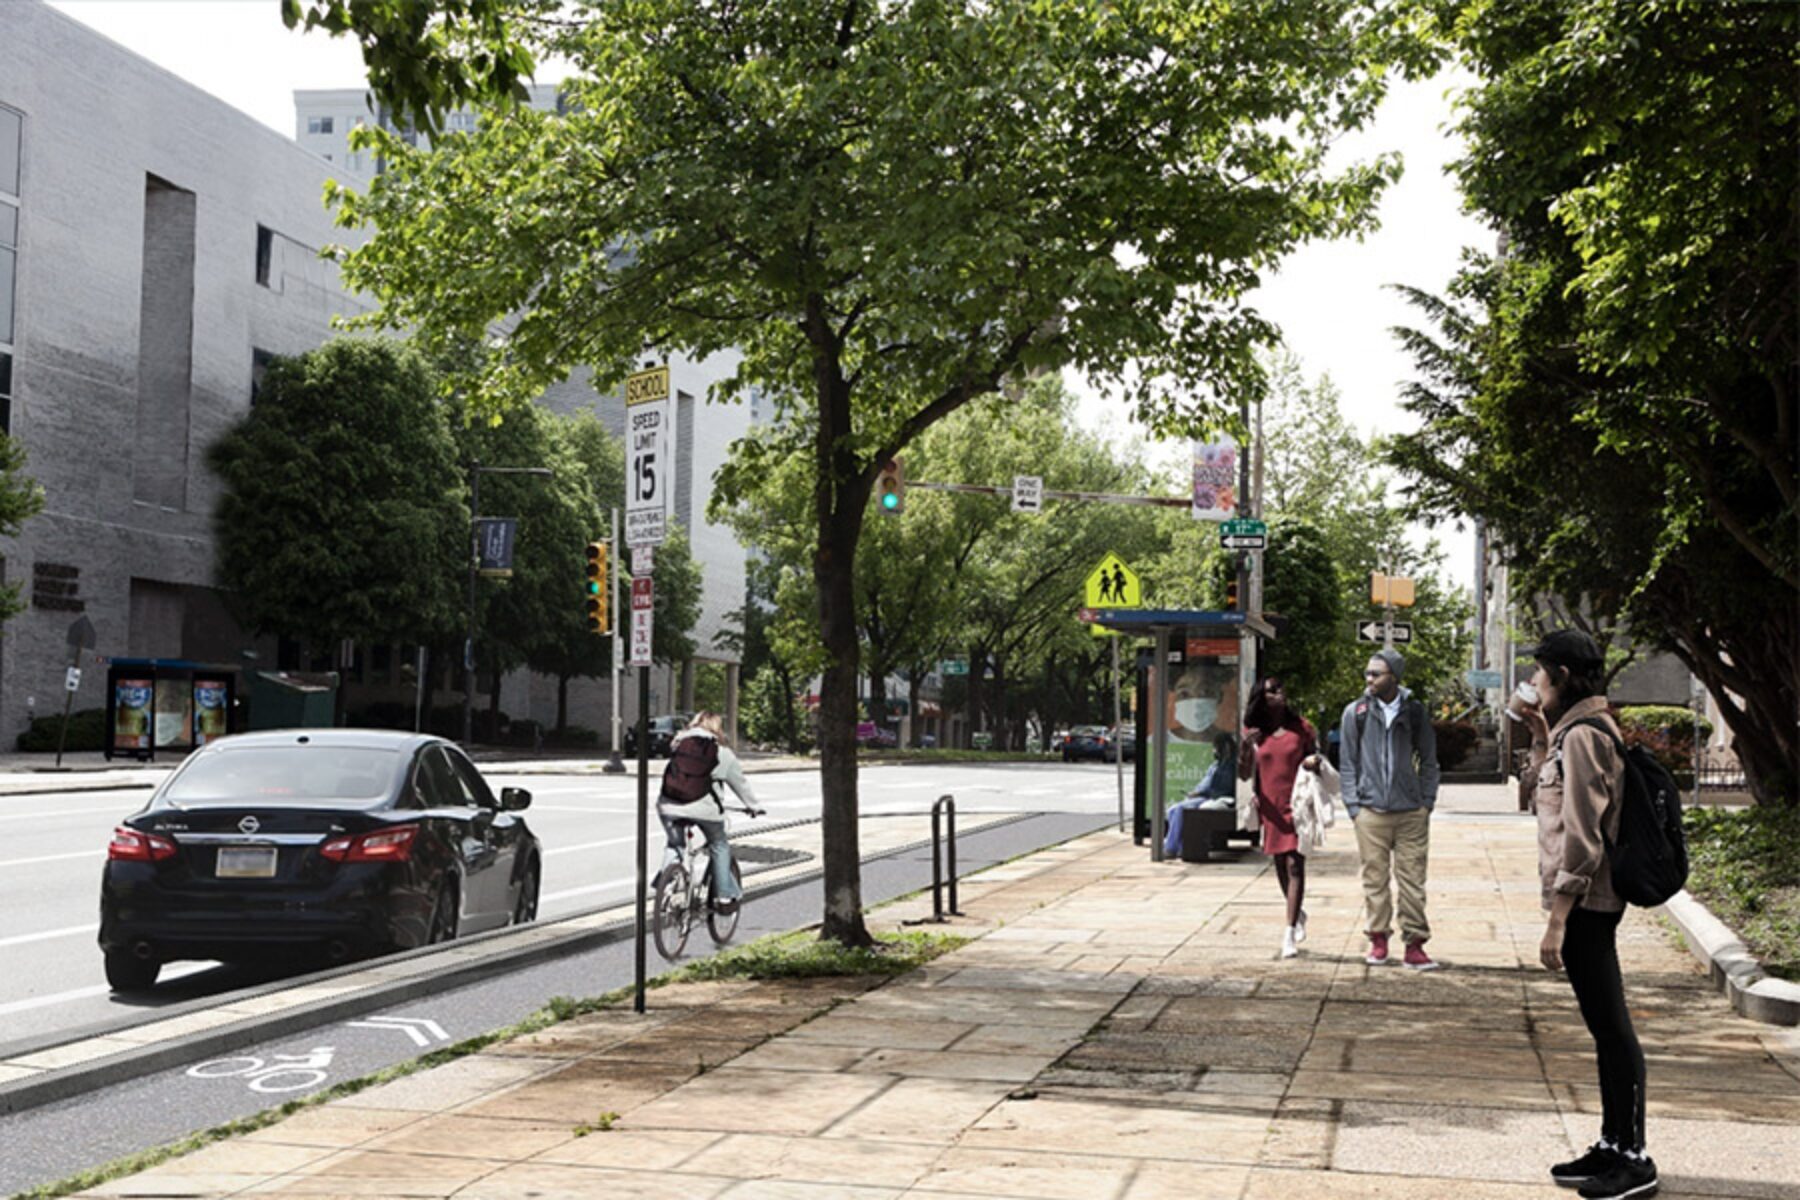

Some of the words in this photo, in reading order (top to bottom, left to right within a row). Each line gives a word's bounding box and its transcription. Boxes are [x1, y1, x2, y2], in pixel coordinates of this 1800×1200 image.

[629, 374, 665, 400] SCHOOL
[633, 410, 660, 431] SPEED
[634, 432, 656, 451] LIMIT
[634, 453, 655, 501] 15
[1018, 478, 1038, 488] ONE
[1017, 489, 1037, 497] WAY
[1166, 765, 1204, 779] ealth
